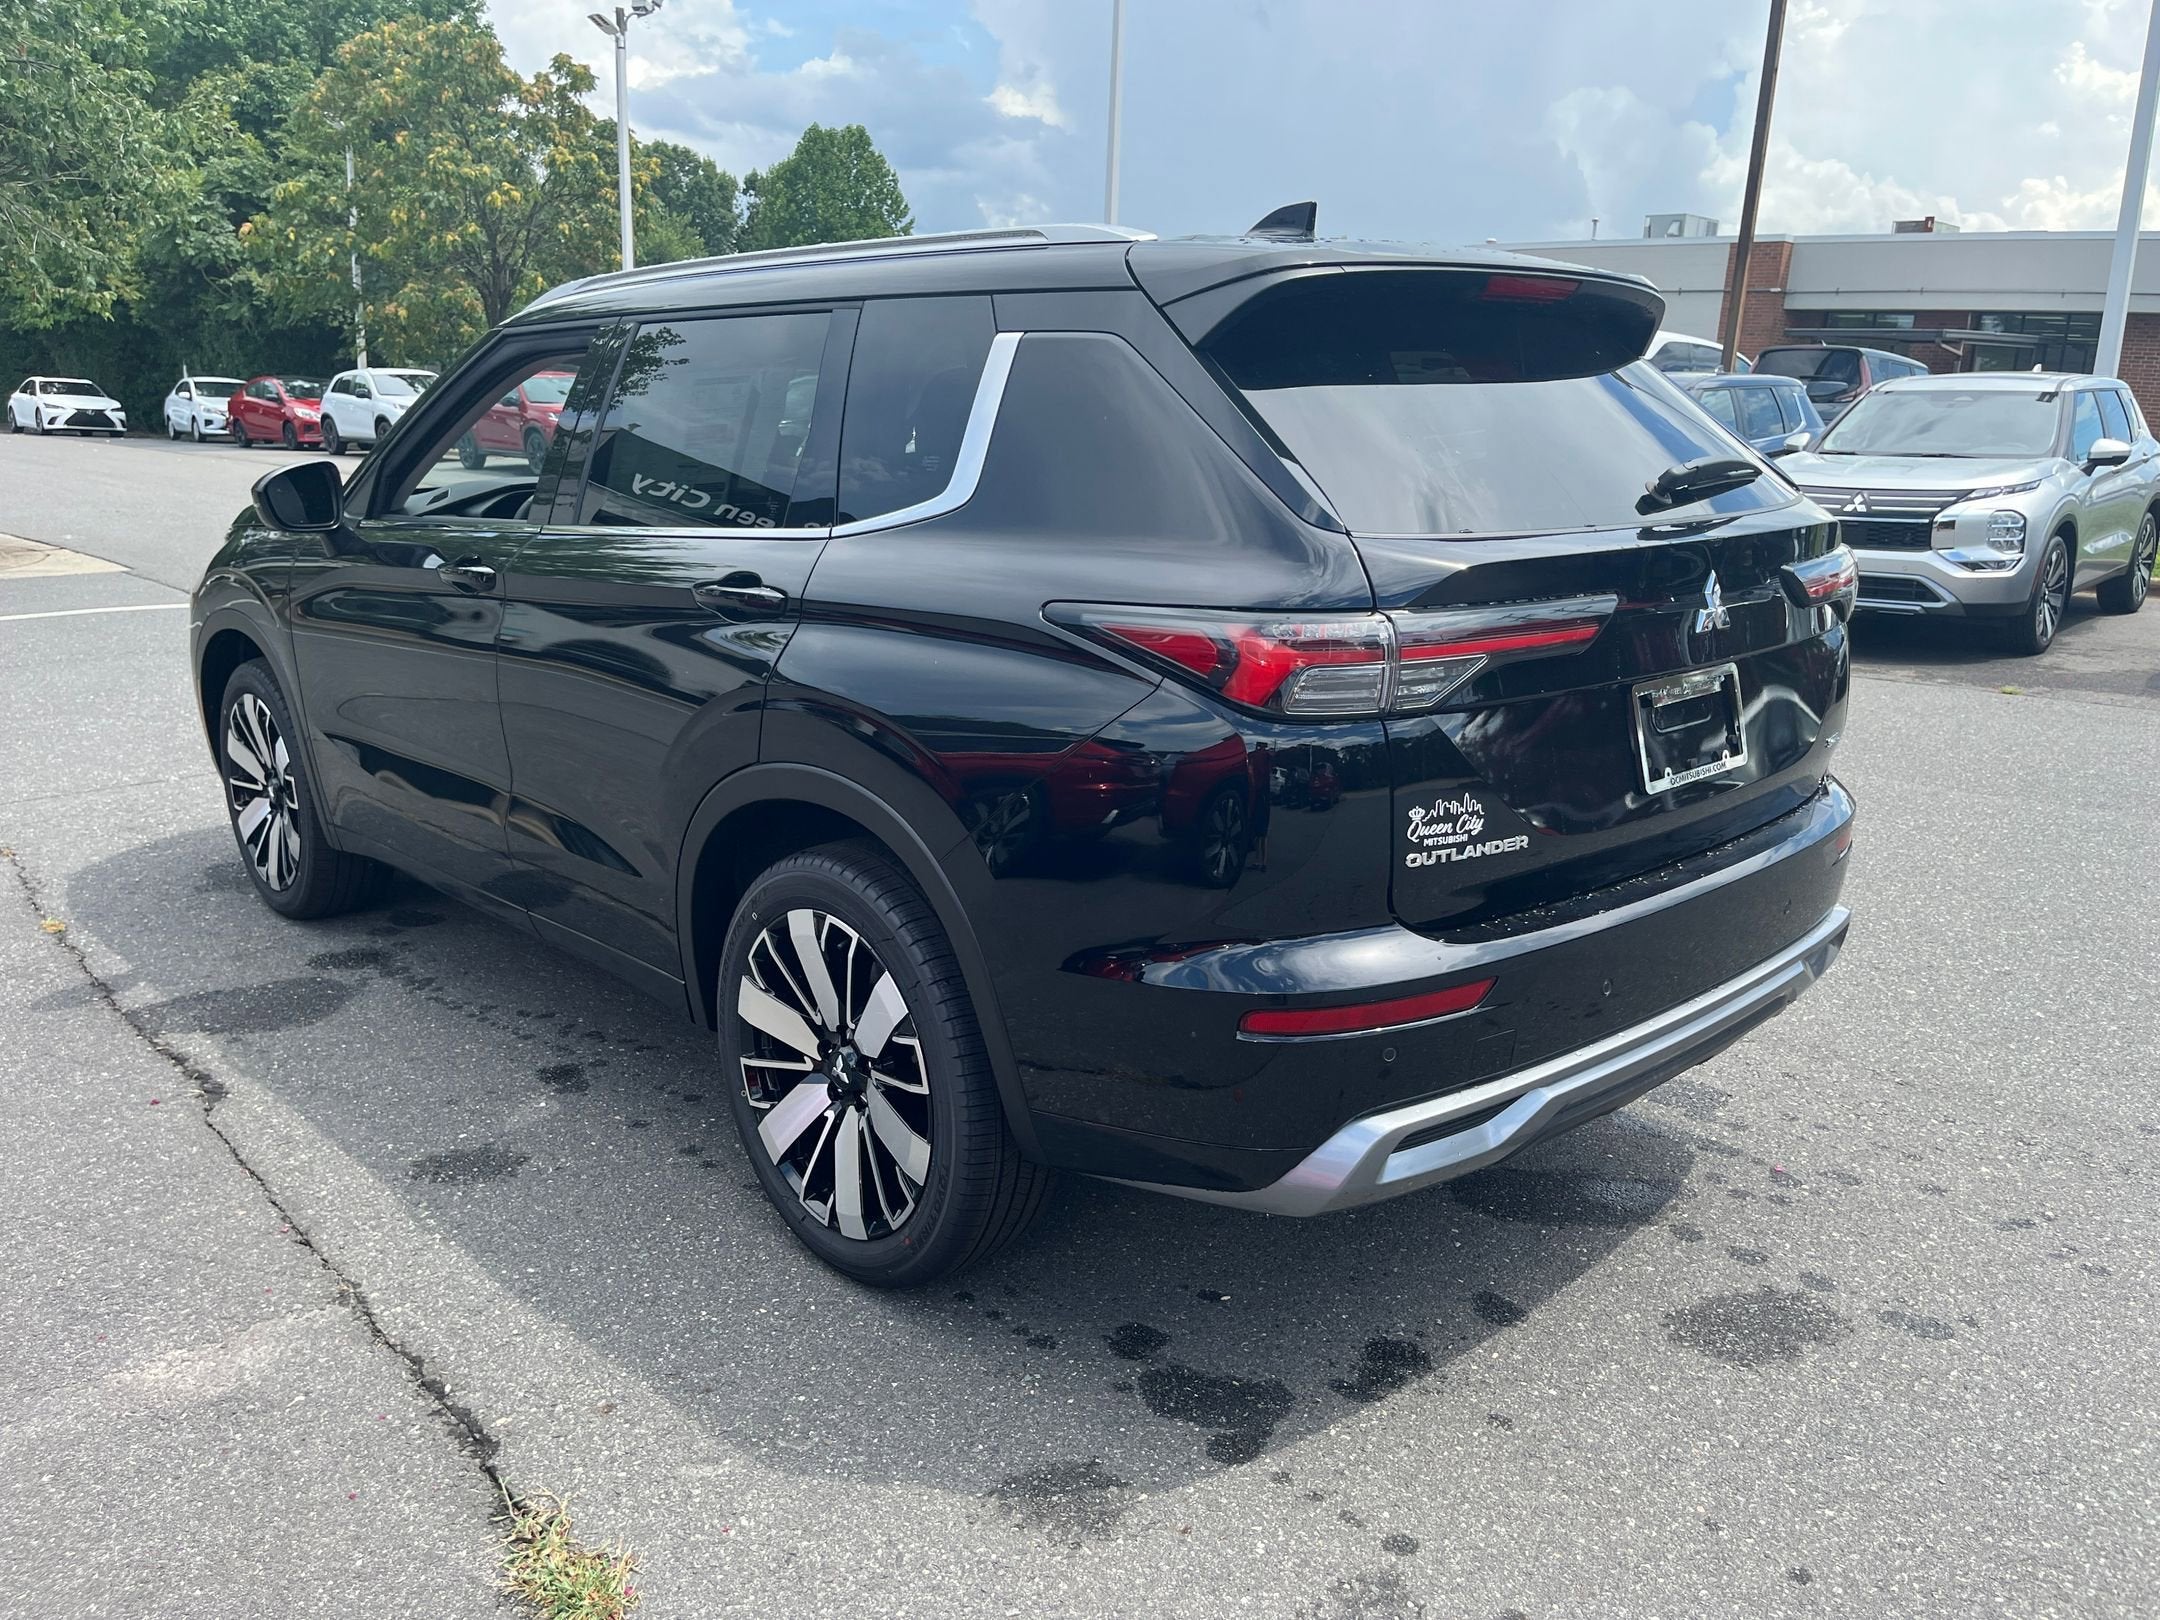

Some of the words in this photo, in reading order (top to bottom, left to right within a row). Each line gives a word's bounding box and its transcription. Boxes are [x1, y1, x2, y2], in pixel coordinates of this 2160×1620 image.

[1407, 820, 1453, 842] Queen
[1456, 814, 1484, 836] City
[1423, 834, 1468, 847] MITSUBISHI
[1406, 834, 1529, 867] OUTLANDER
